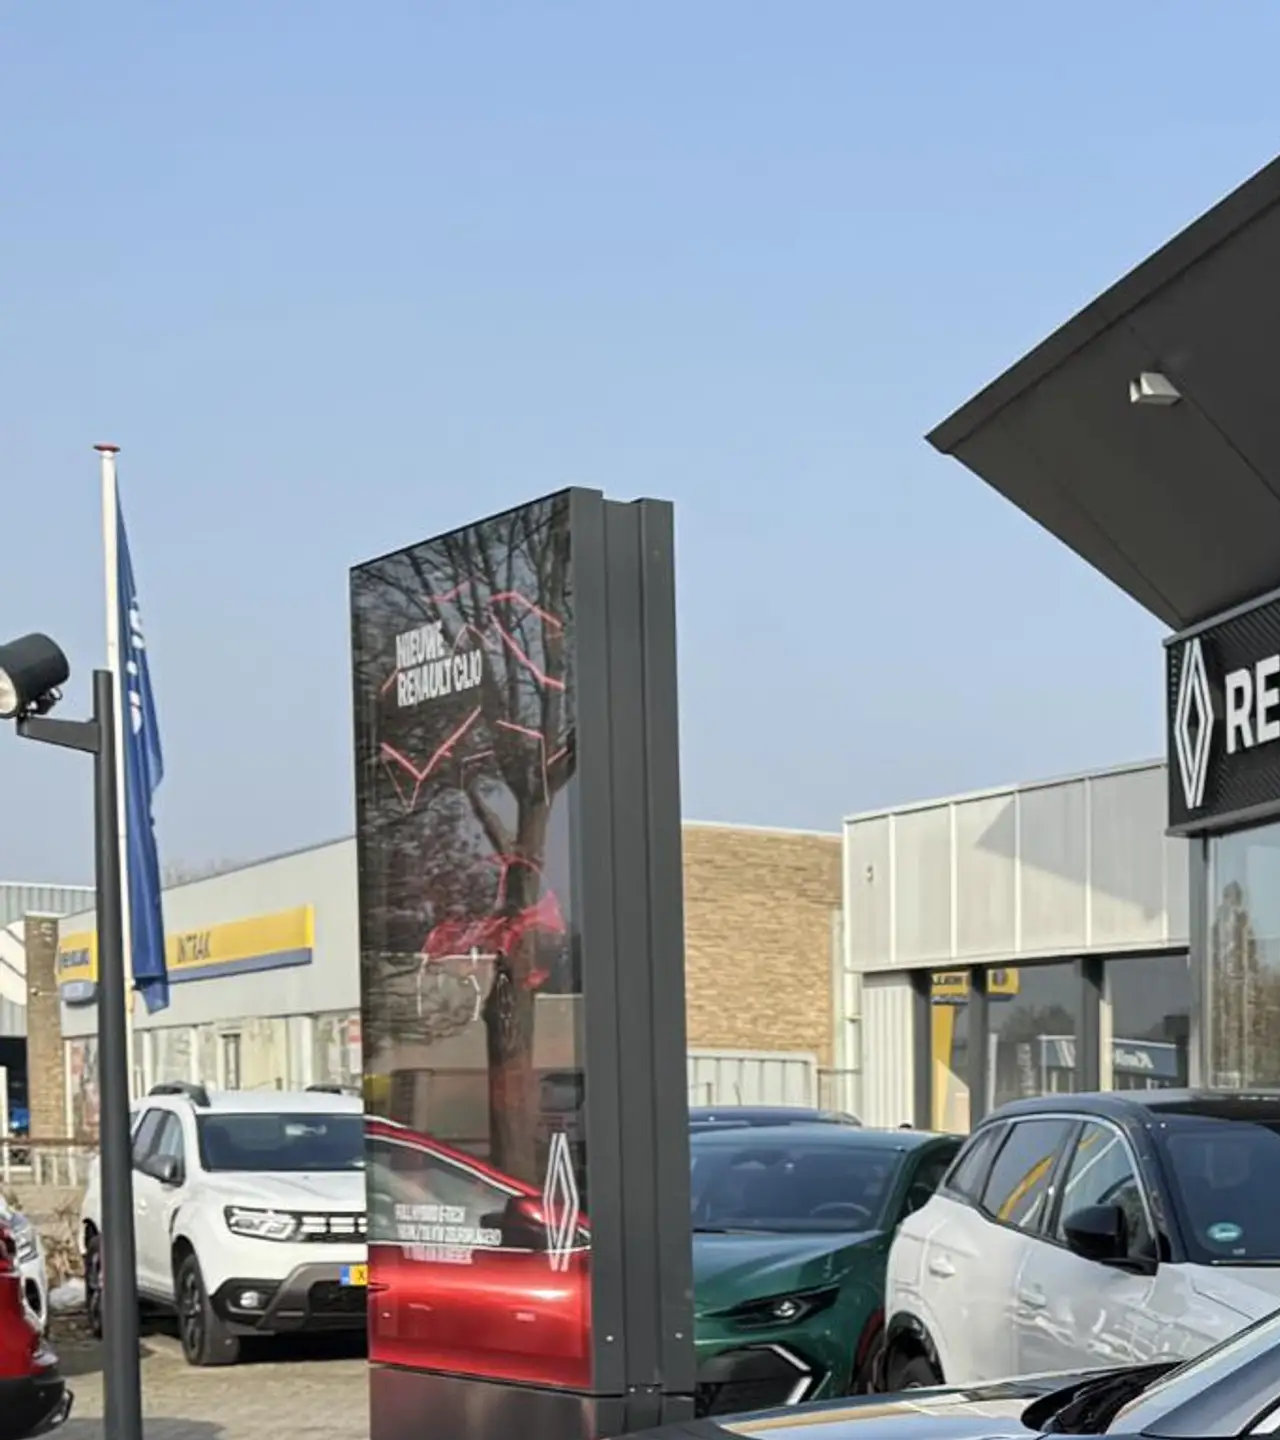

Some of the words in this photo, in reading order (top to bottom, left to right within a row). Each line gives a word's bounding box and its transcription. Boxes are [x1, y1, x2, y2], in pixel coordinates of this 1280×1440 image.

[396, 620, 445, 669] NIEUWE
[398, 658, 451, 707] RENAULT
[453, 650, 482, 691] CLIO
